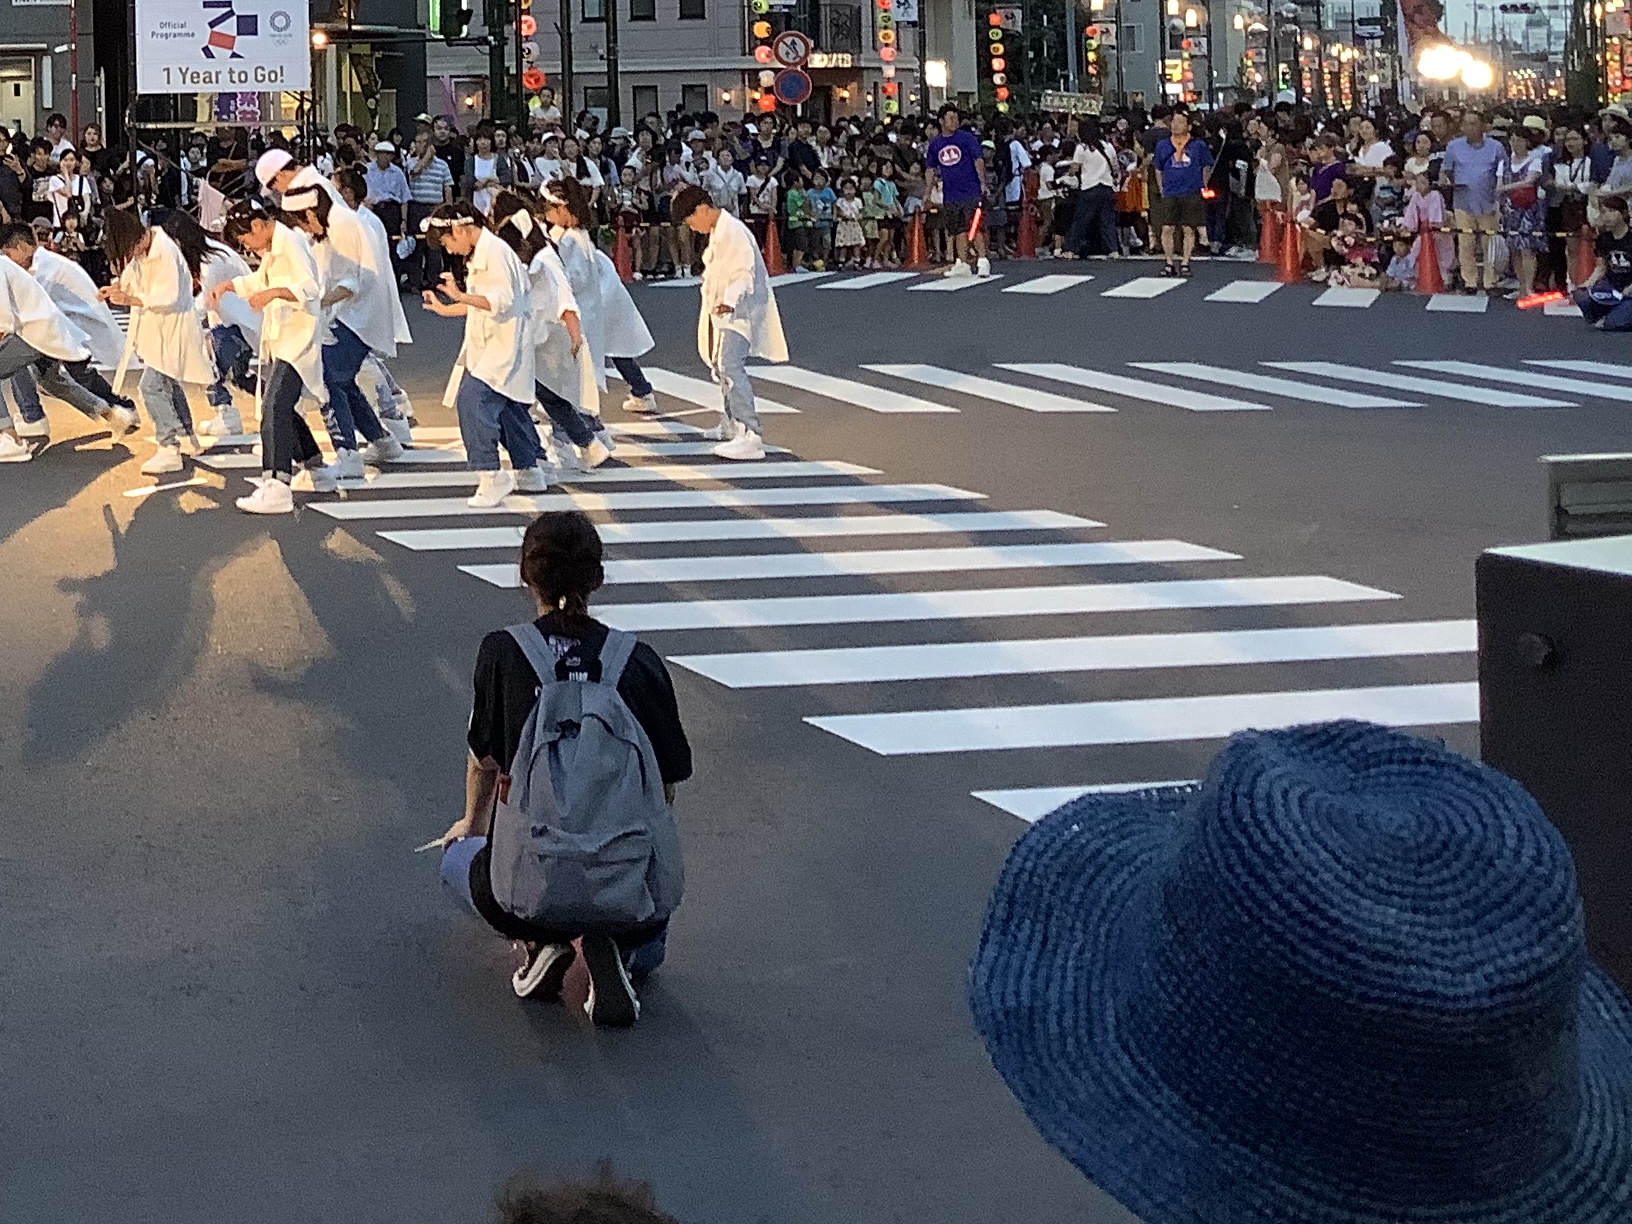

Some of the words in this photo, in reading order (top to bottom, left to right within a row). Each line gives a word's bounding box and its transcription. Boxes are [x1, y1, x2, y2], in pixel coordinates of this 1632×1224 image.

[159, 21, 187, 29] Official
[151, 31, 195, 41] Programme
[162, 67, 171, 85] 1
[178, 67, 222, 85] Year
[228, 67, 248, 84] to
[254, 65, 285, 84] Go!
